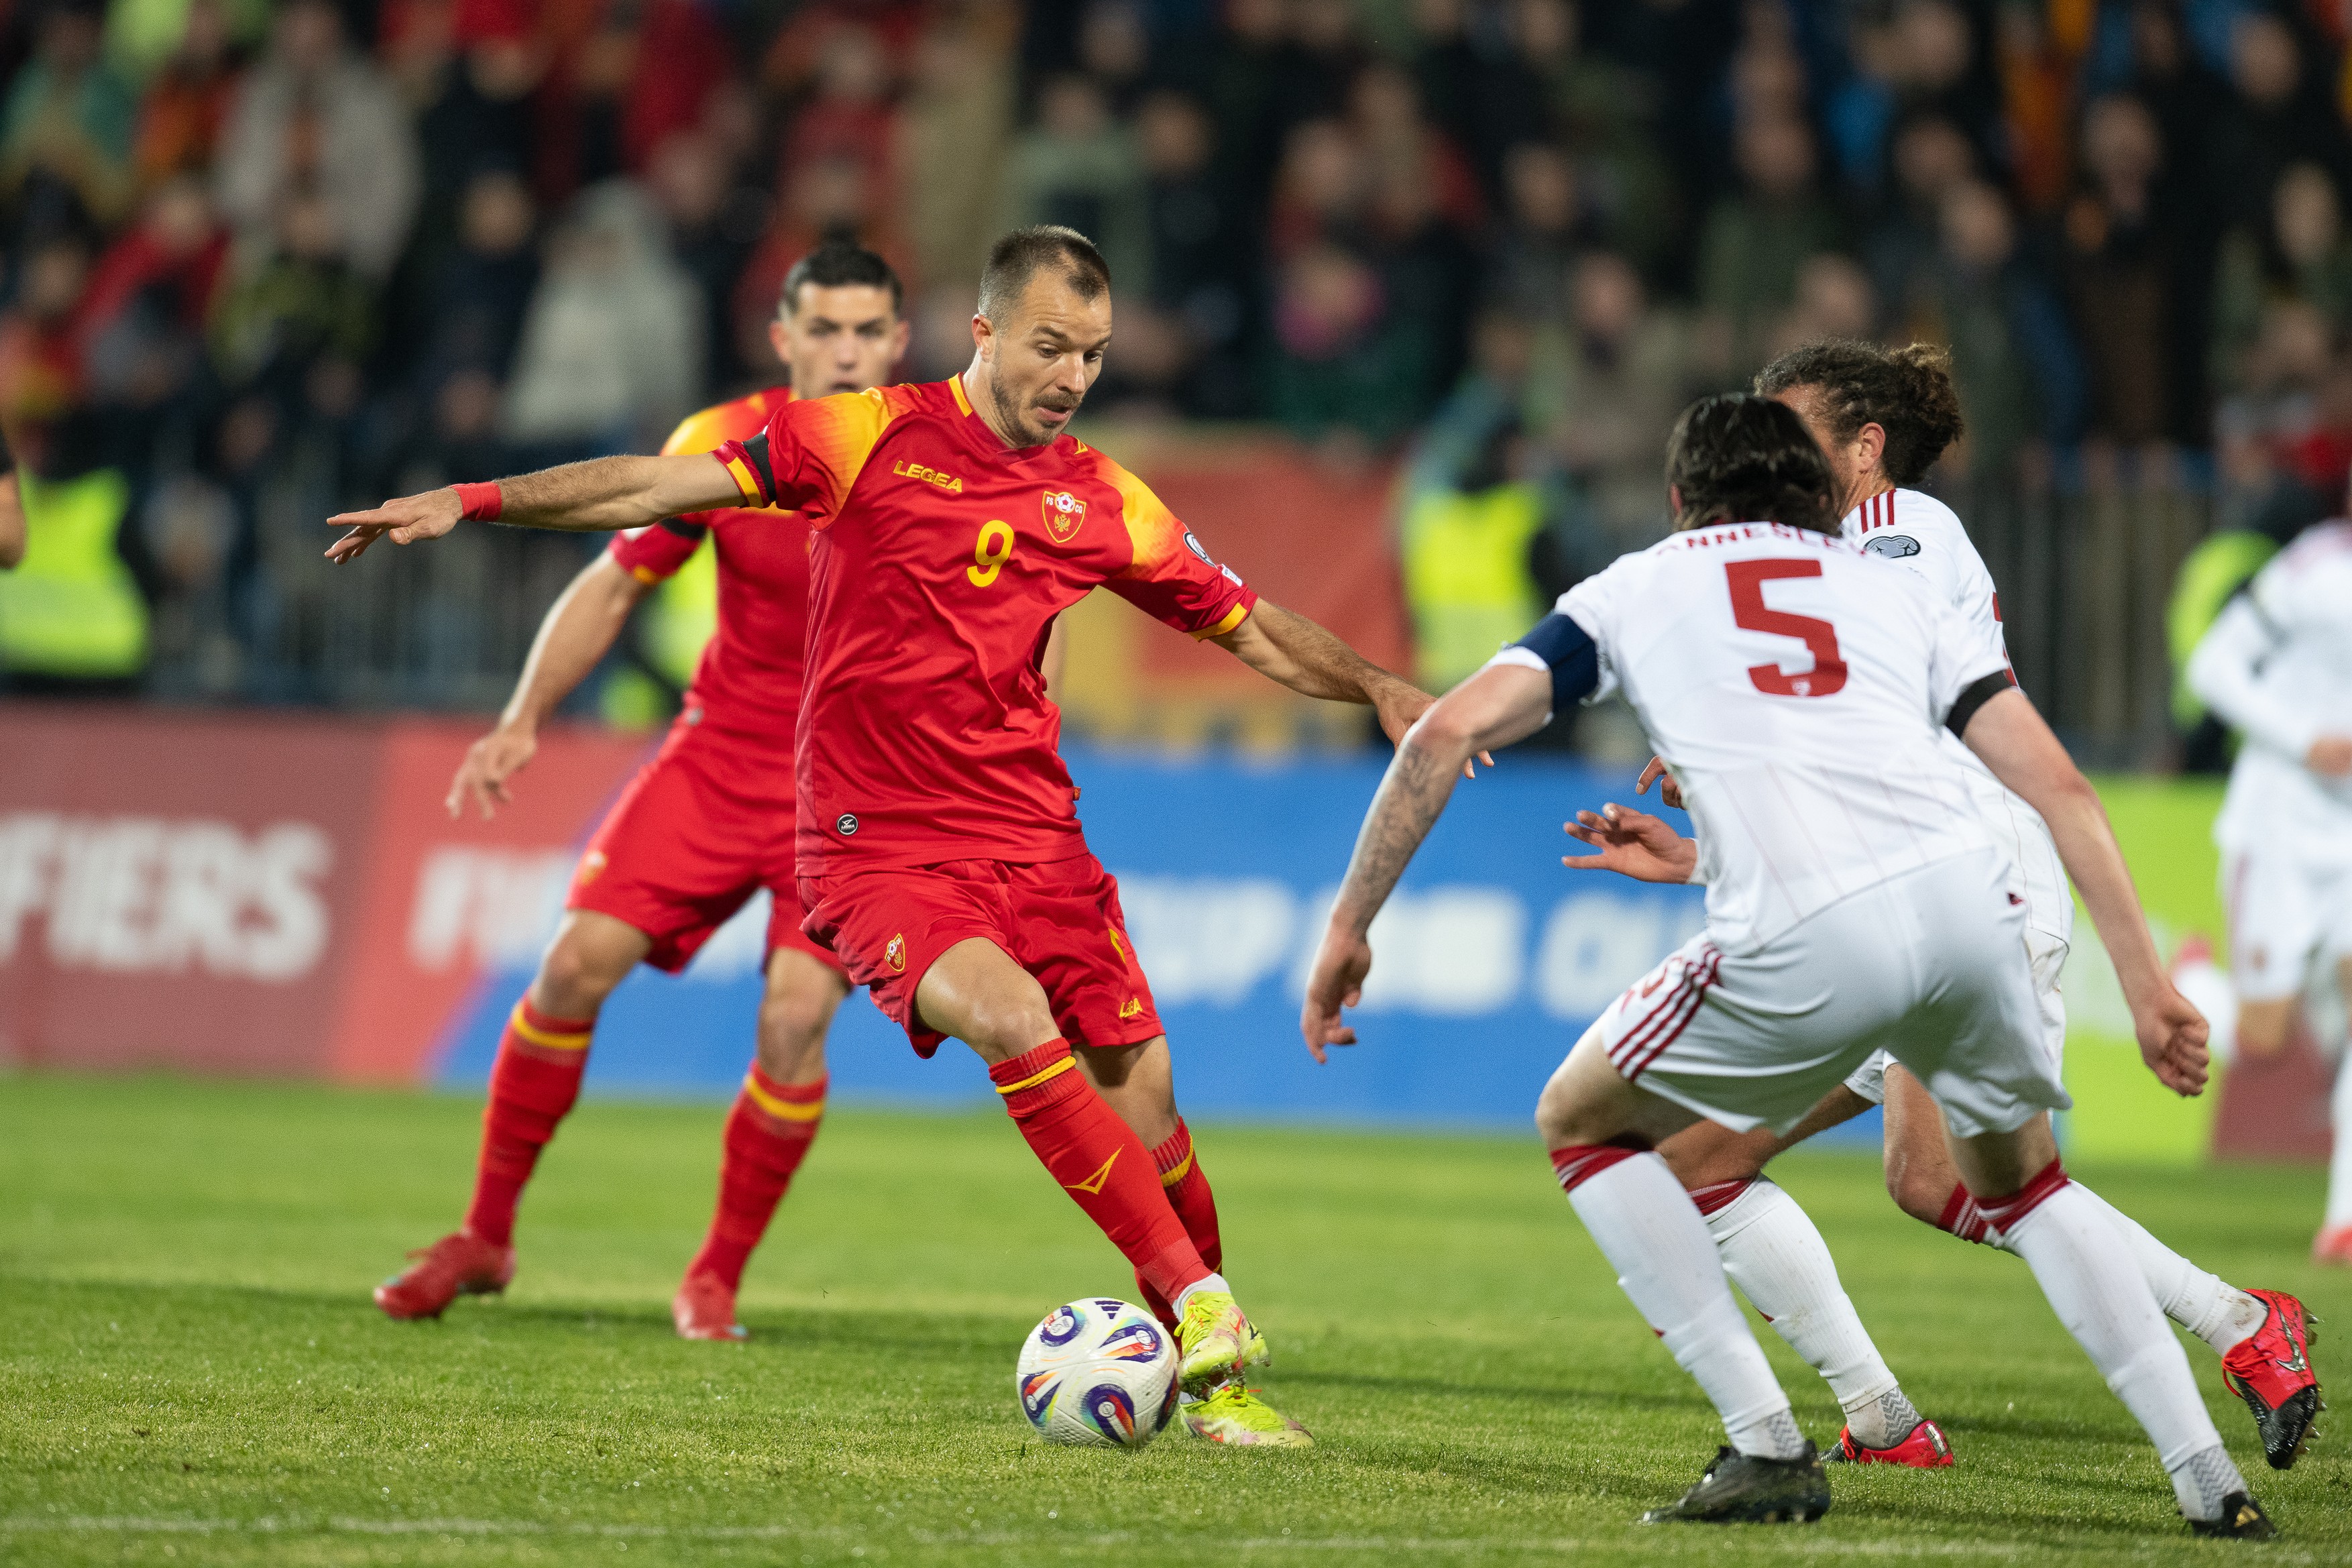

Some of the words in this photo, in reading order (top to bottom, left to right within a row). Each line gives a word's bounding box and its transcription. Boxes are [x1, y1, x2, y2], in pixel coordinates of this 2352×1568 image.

[893, 460, 962, 493] LEGEA
[1046, 496, 1054, 506] FS
[1074, 504, 1083, 514] CG
[967, 519, 1014, 587] 9
[1724, 558, 1848, 697] 5
